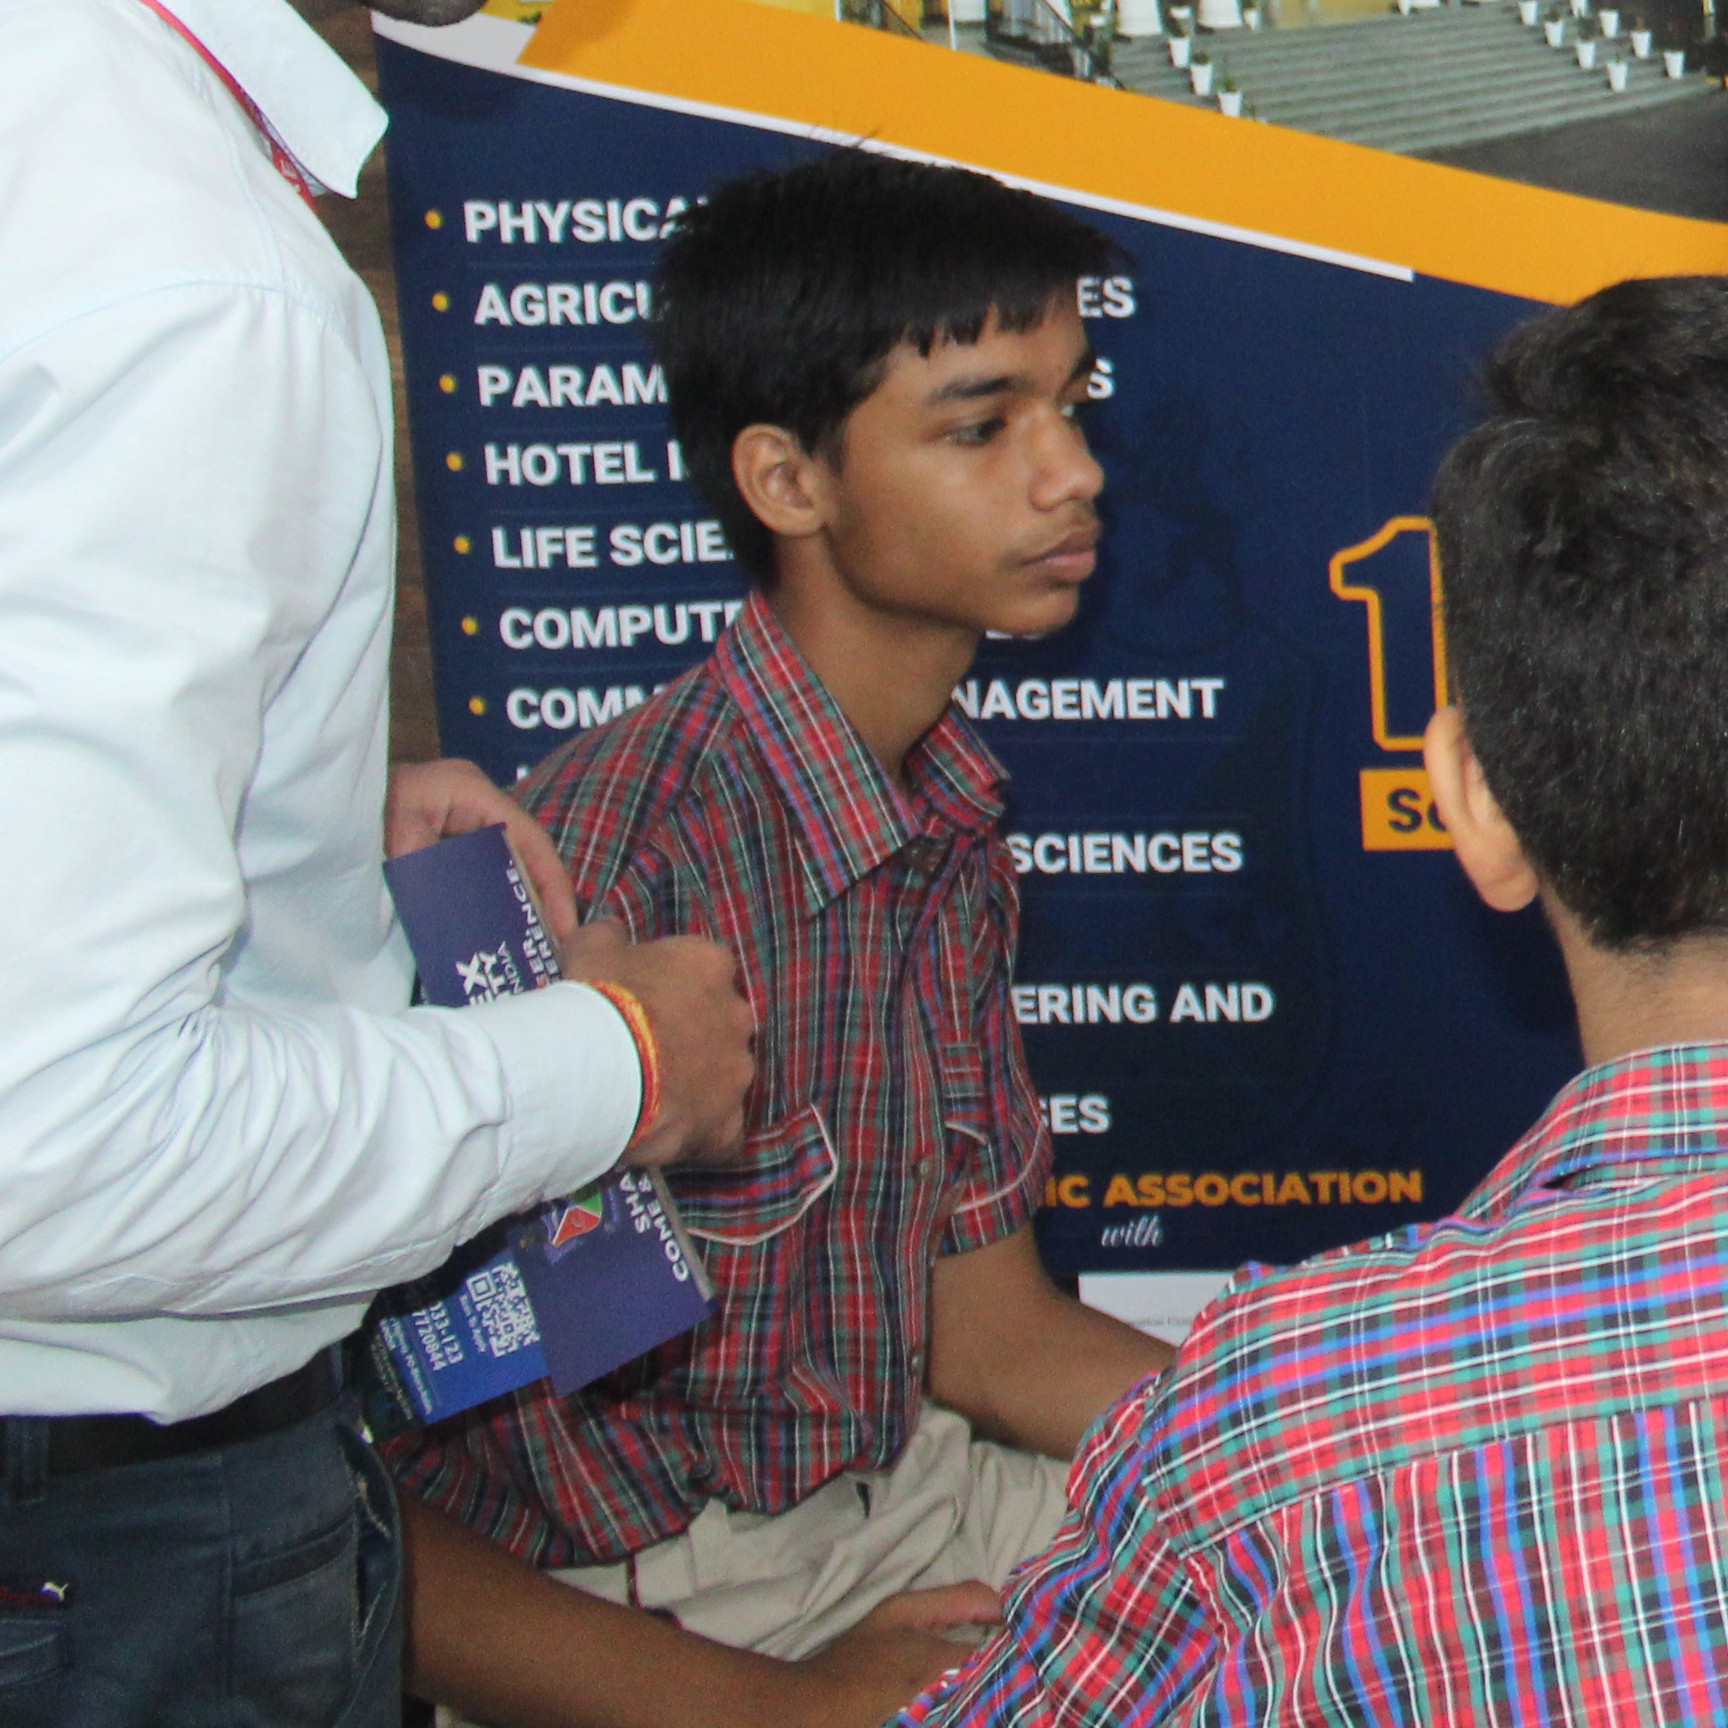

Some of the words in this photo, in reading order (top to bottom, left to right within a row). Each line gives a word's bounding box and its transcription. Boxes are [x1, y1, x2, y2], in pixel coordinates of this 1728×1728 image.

[484, 440, 657, 487] HOTEL
[491, 524, 598, 569] LIFE
[609, 520, 735, 567] SCIE
[1006, 832, 1243, 874] SCIENCES
[1169, 981, 1275, 1024] AND
[1102, 1169, 1423, 1209] ASSOCIATION
[647, 1199, 689, 1282] COME
[1100, 1212, 1163, 1249] with
